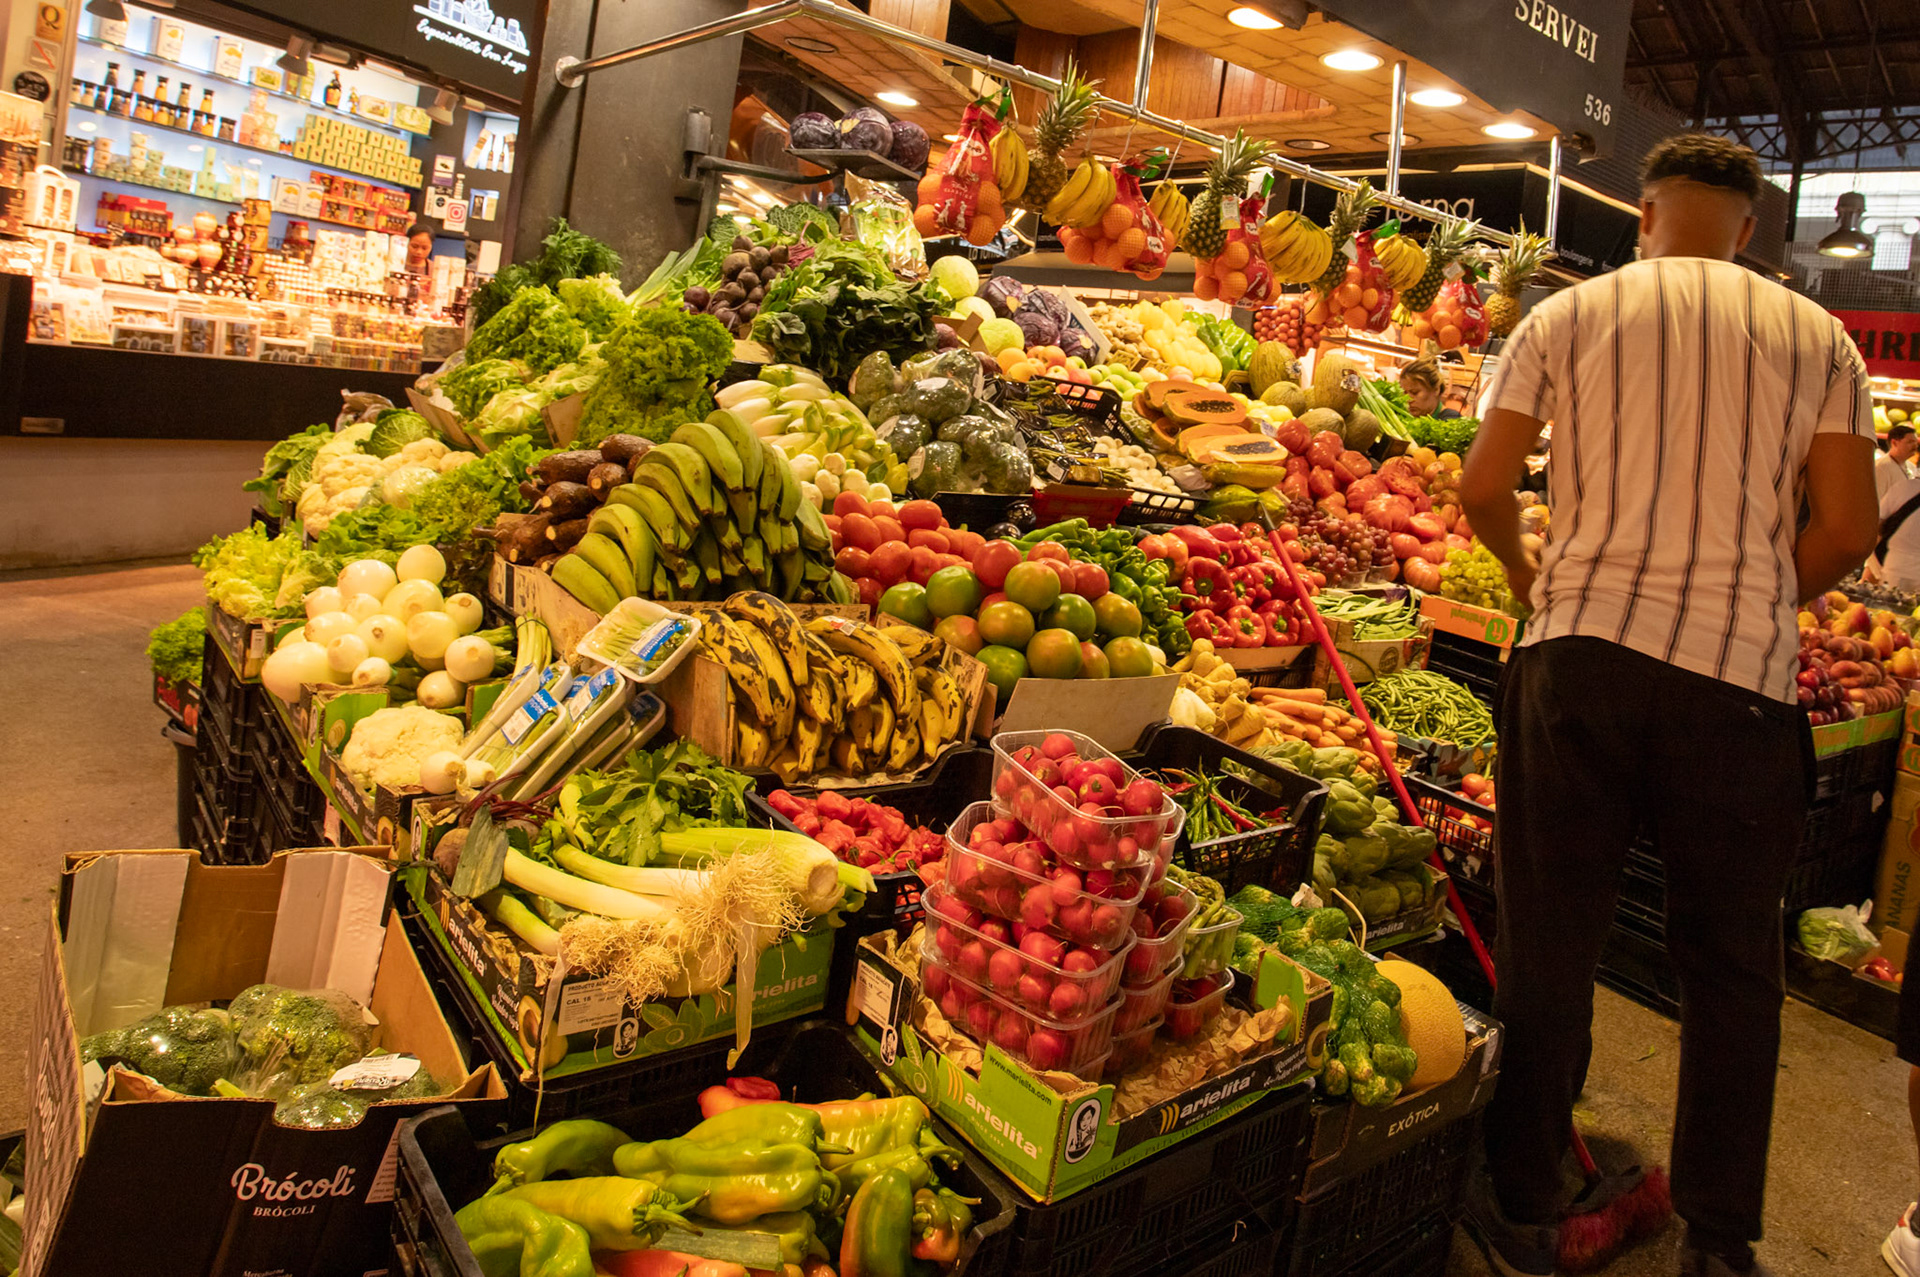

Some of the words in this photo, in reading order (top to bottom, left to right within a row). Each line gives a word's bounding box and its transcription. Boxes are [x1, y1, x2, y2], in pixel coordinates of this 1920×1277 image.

[1515, 0, 1598, 63] SERVEI
[1584, 93, 1612, 126] 536
[752, 973, 819, 1001] rielita
[989, 1054, 1052, 1106] www.marielita.com
[1387, 1102, 1441, 1138] EXÓTICA
[230, 1162, 356, 1202] Brócoli
